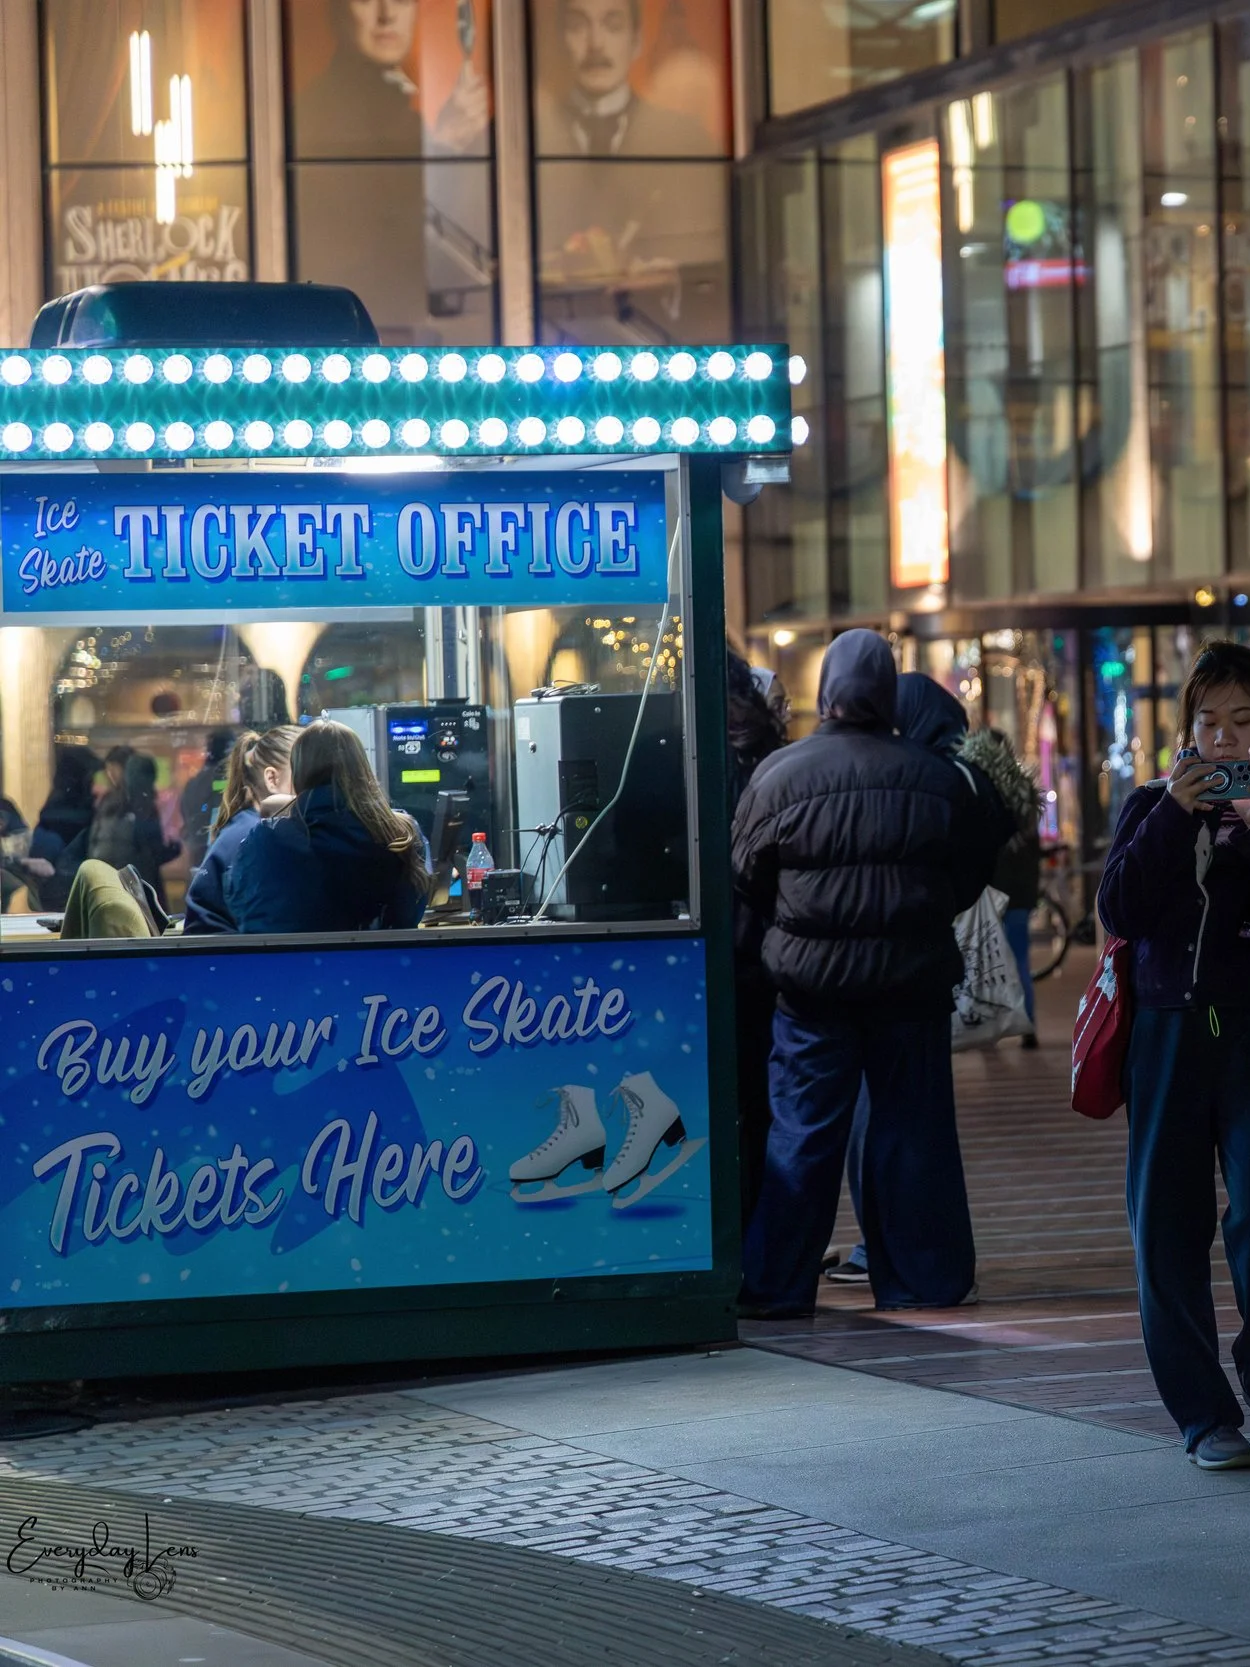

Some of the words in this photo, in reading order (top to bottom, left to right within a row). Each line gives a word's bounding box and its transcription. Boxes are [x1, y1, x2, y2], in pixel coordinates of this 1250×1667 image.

[33, 496, 80, 539] Ice
[113, 503, 370, 580] TICKET
[397, 501, 638, 577] OFFICE
[18, 545, 108, 595] Skate
[37, 1018, 175, 1104] Buy
[188, 1017, 334, 1099] your
[354, 994, 447, 1066] Ice
[461, 975, 632, 1054] Skate
[33, 1131, 285, 1255] Tickets
[302, 1110, 482, 1223] Here
